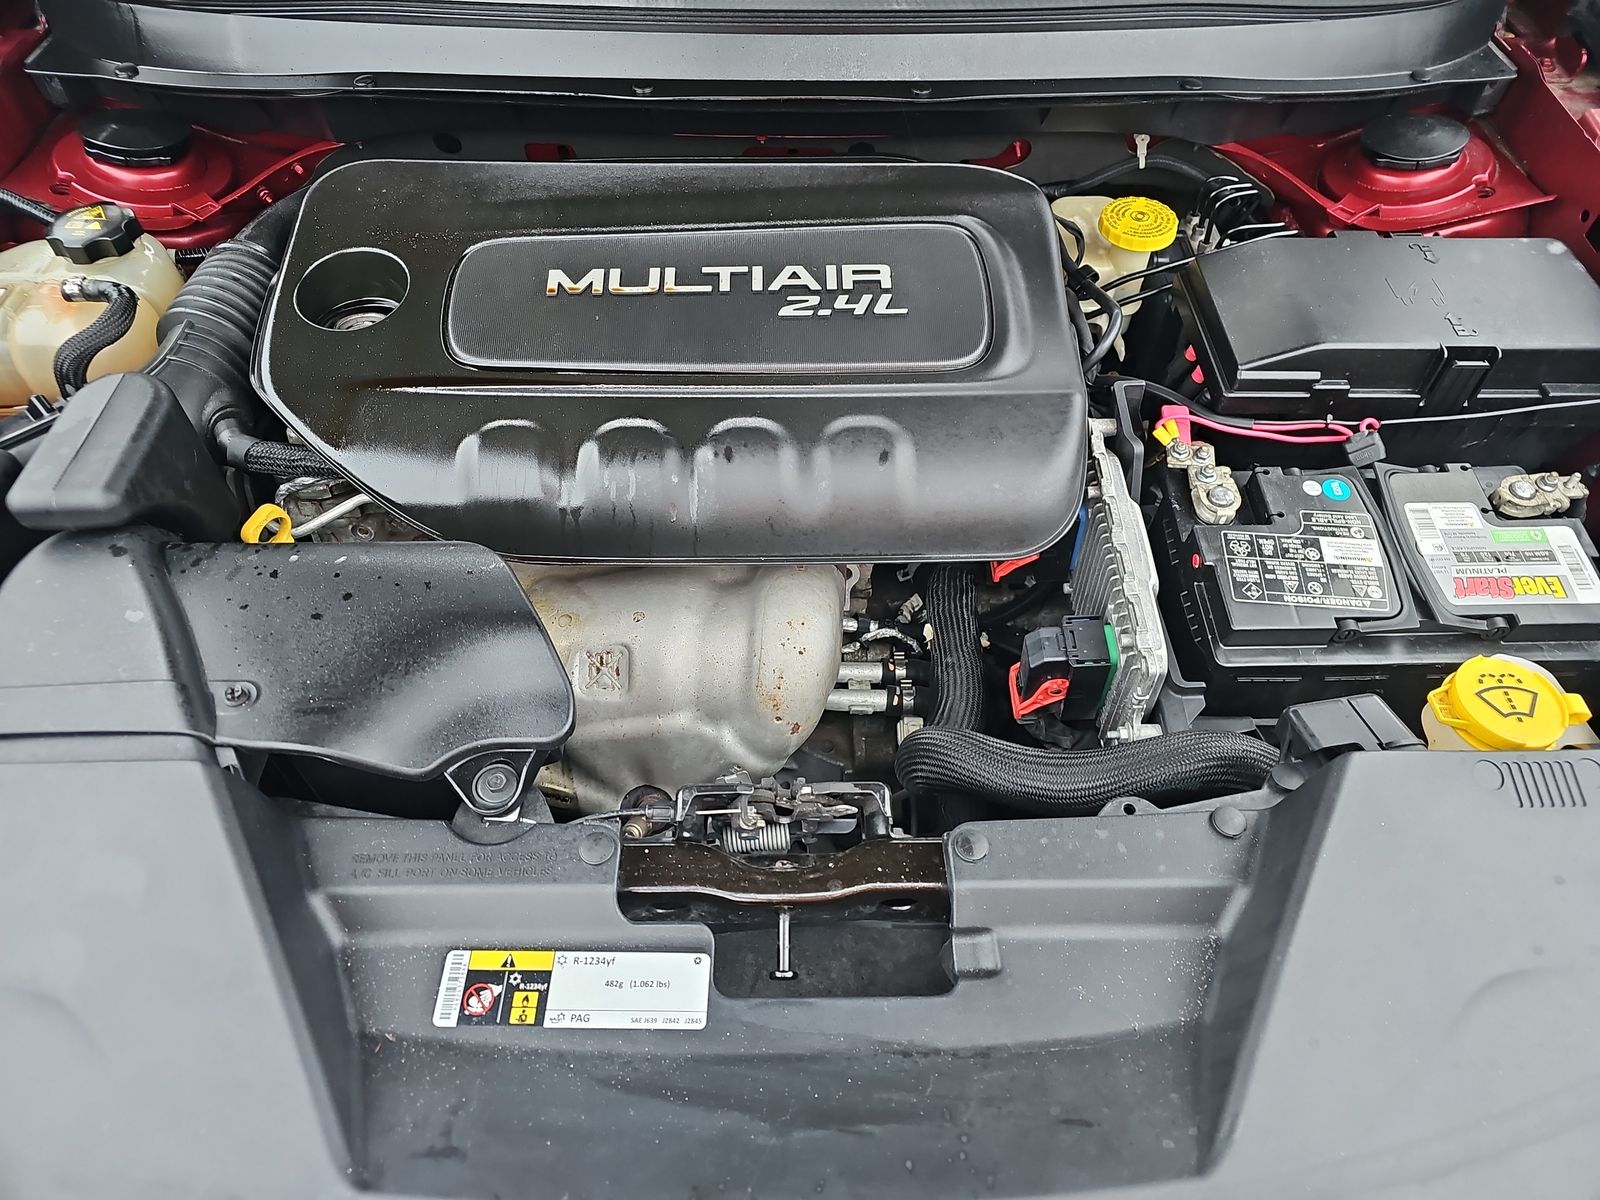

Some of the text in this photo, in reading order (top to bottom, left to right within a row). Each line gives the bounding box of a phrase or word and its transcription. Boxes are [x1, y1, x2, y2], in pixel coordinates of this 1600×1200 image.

[546, 264, 892, 297] MULTIAIR
[777, 294, 909, 316] 2.4L
[1455, 567, 1508, 575] PLATINUM
[1453, 576, 1568, 600] EverStart
[404, 853, 428, 863] THIS
[574, 957, 616, 966] R-1234yf
[605, 980, 670, 989] 482g (1.062 lbs)
[571, 1014, 590, 1022] PAG
